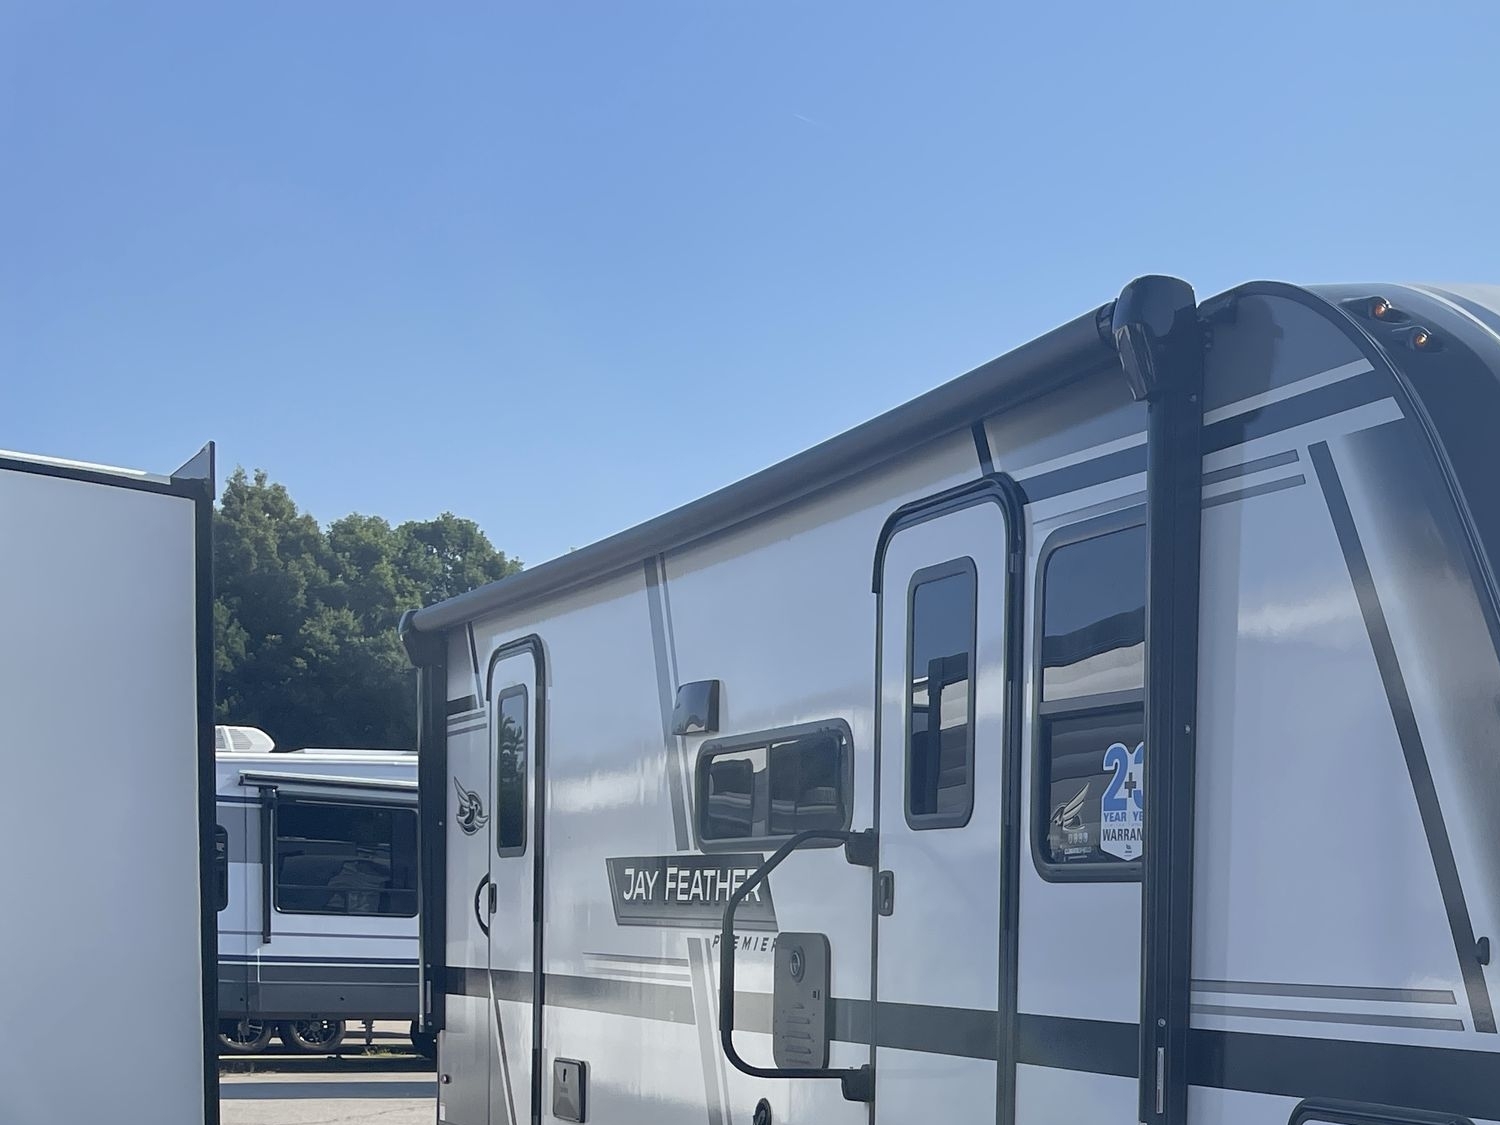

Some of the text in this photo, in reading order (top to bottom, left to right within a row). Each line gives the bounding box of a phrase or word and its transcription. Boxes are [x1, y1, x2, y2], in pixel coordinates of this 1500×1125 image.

[1103, 811, 1127, 822] YEAR
[1102, 828, 1142, 841] WARRAN
[623, 866, 761, 901] JAY FEATHER
[712, 934, 777, 952] PEMIE
